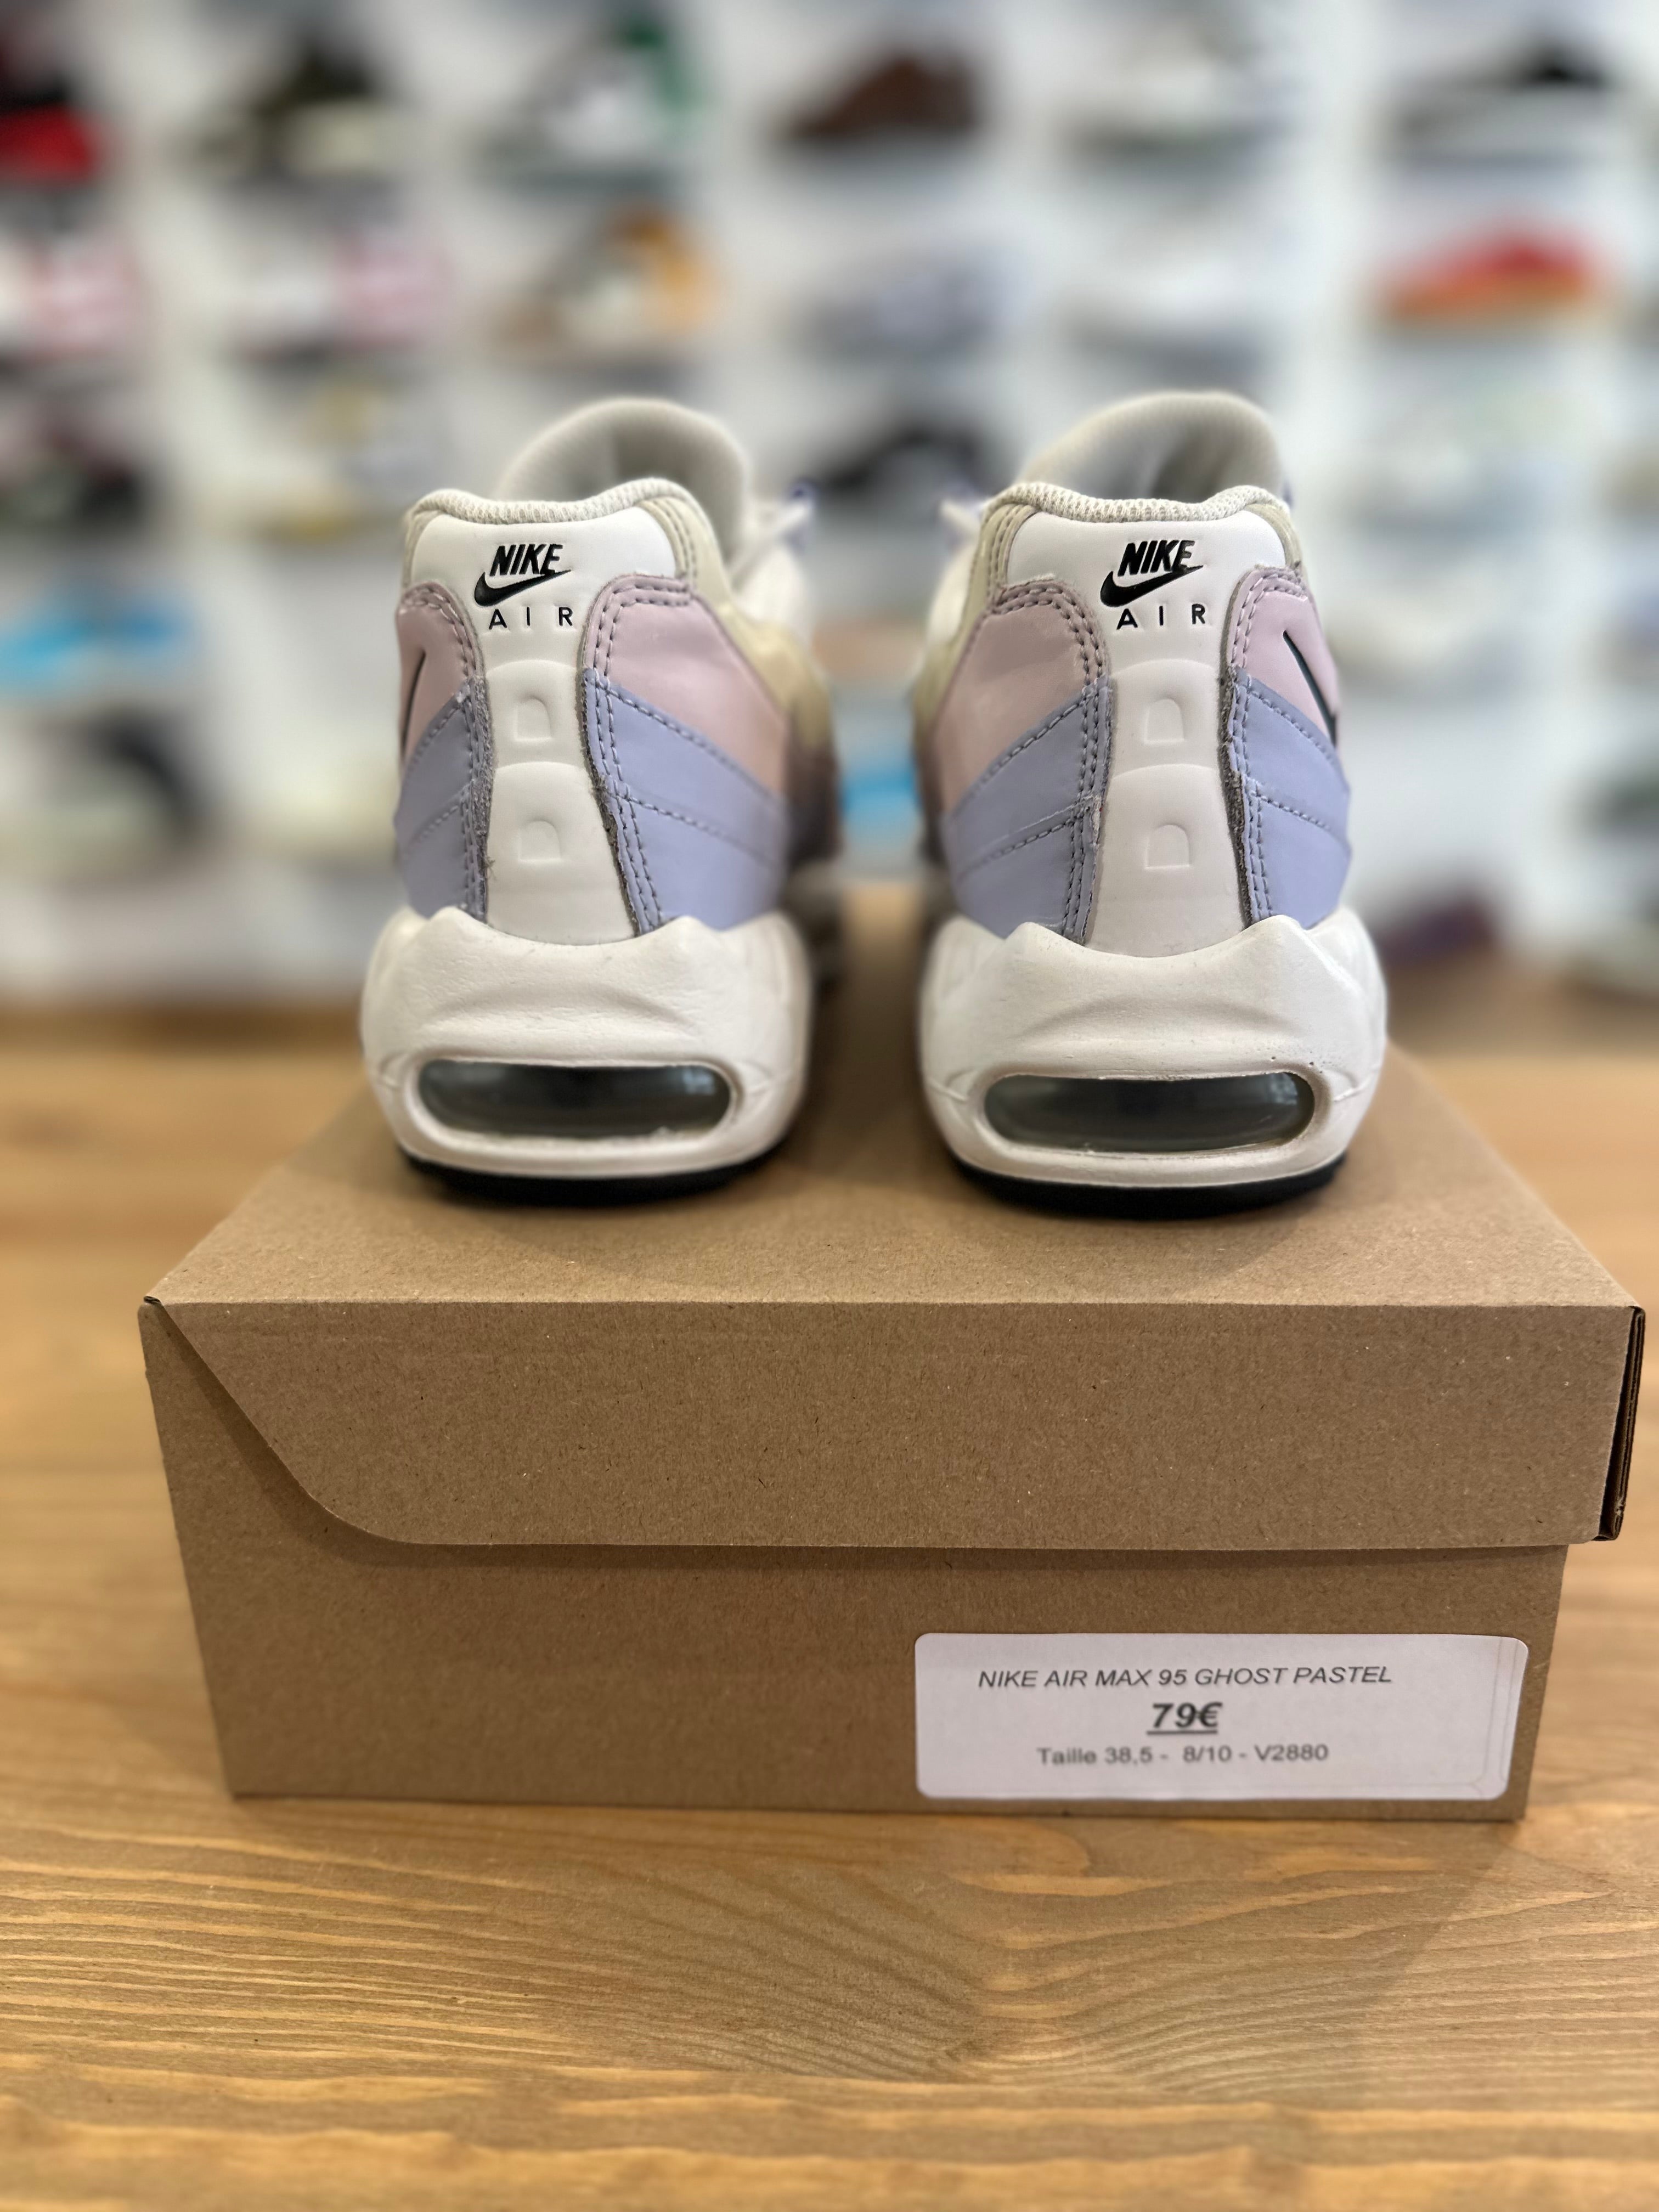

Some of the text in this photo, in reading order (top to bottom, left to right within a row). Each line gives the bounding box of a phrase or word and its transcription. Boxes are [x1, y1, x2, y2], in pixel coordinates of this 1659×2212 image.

[489, 544, 563, 577] NIKE
[1117, 540, 1195, 577] NIKE
[489, 606, 573, 629] AIR
[1116, 603, 1206, 630] AIR
[978, 1666, 1392, 1688] NIKE AIR MAX 95 GHOST PASTEL
[1151, 1701, 1223, 1730] 79€
[1038, 1747, 1097, 1765] Taille
[1105, 1746, 1153, 1765] 38,5
[1182, 1745, 1233, 1763] 8/10
[1254, 1743, 1329, 1762] V2880
